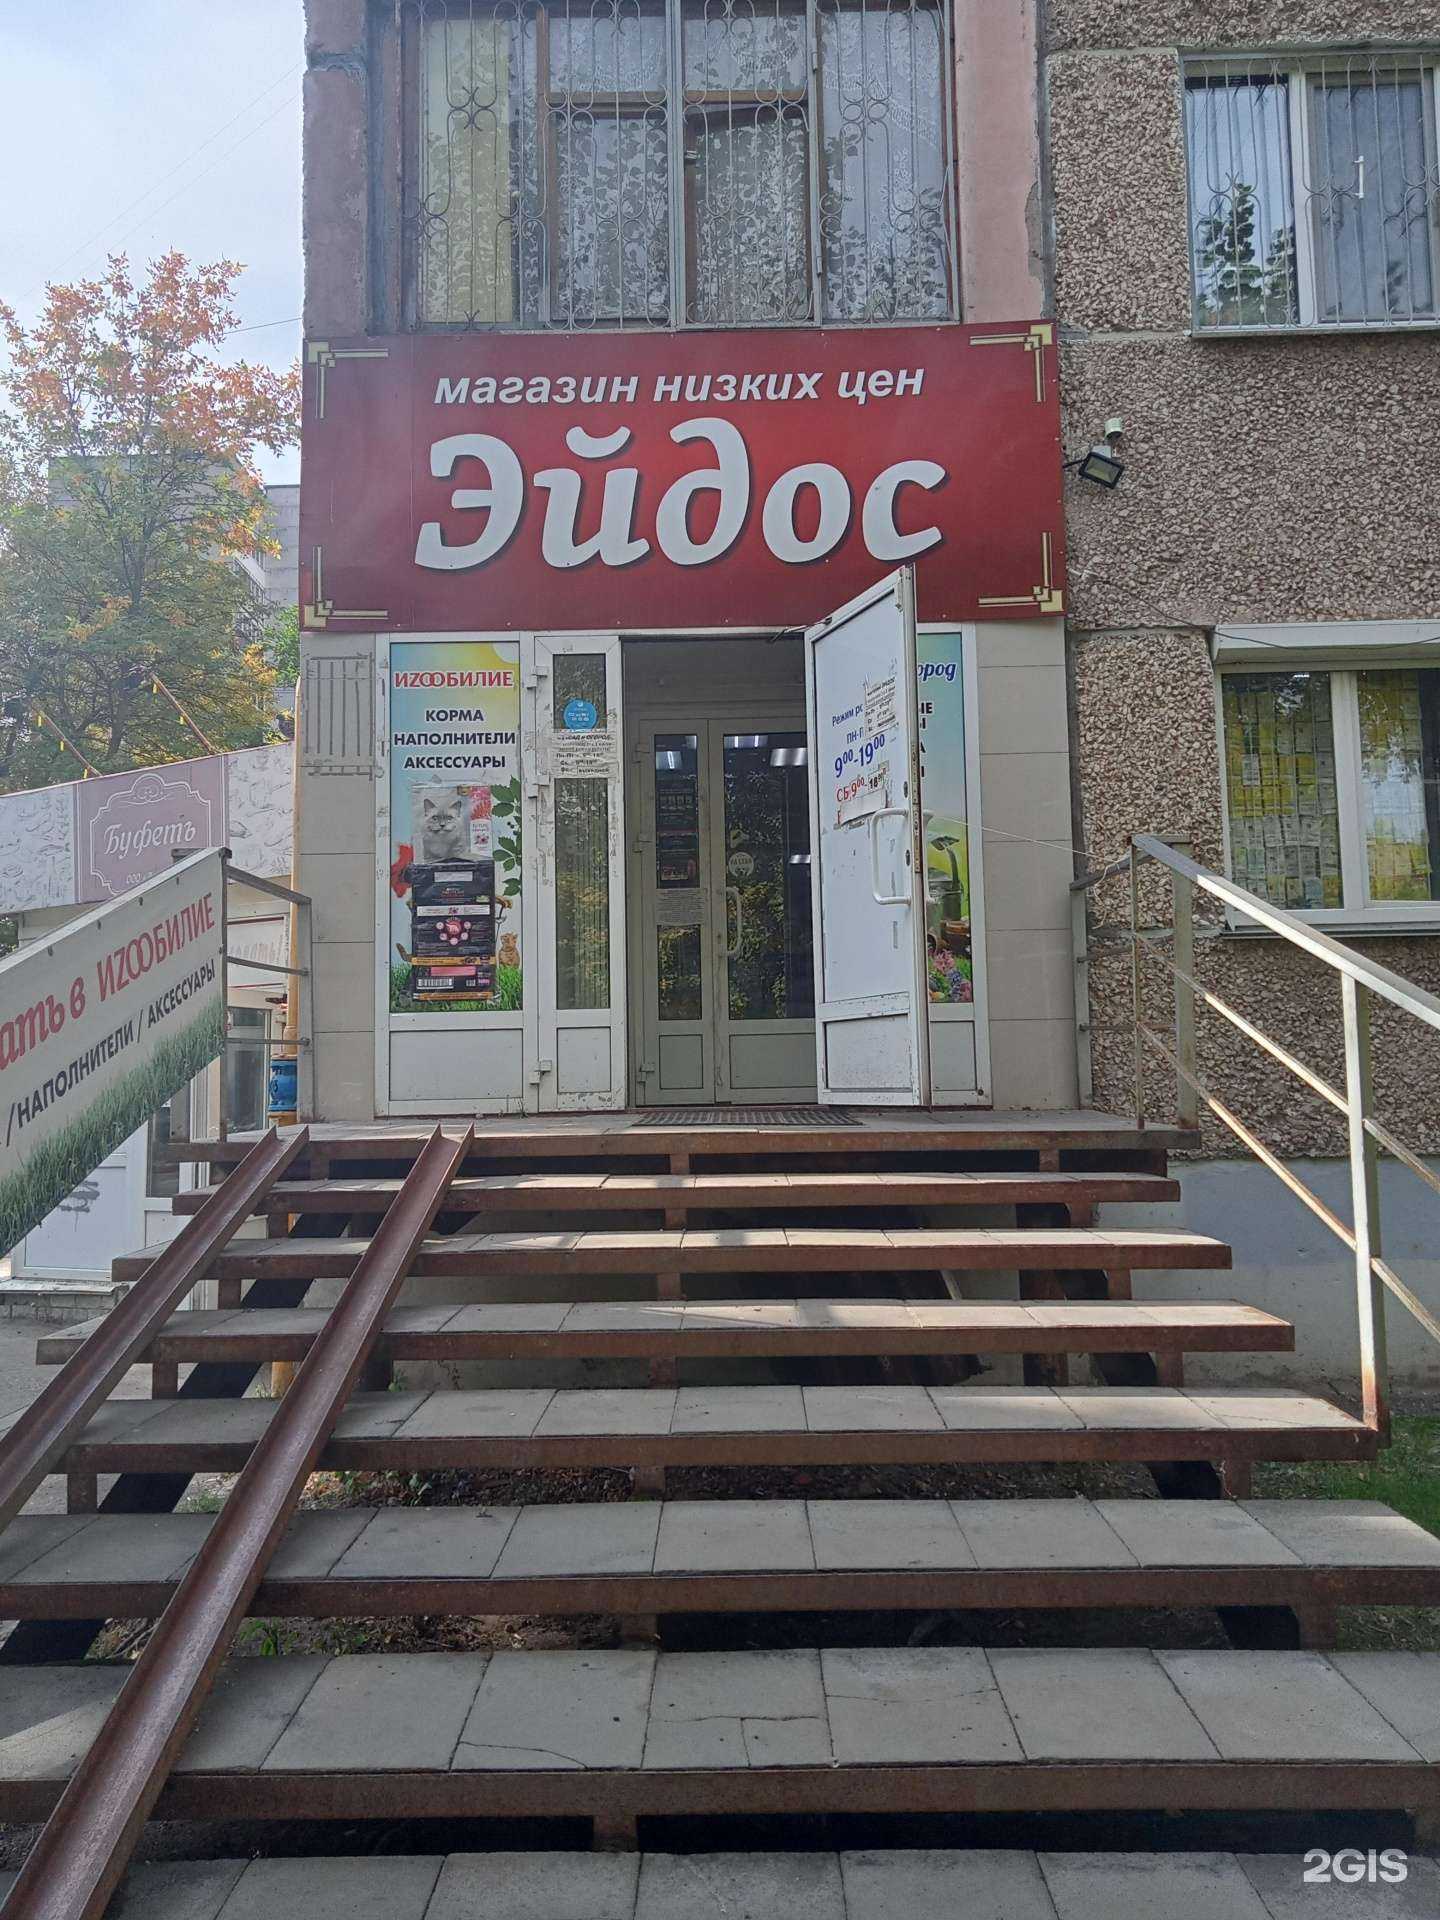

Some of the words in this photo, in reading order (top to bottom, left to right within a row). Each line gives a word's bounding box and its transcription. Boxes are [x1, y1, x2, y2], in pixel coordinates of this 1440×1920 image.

[433, 373, 640, 405] магазин
[652, 369, 823, 402] низких
[837, 366, 925, 401] цен
[414, 417, 947, 570] Эйдос
[425, 709, 484, 722] КОРМА
[394, 732, 516, 747] НАПОЛНИТЕЛИ
[404, 756, 506, 769] АКСЕССУАРЫ
[104, 820, 197, 860] Буфетъ
[0, 995, 66, 1071] ать
[70, 976, 86, 1020] в
[17, 1020, 134, 1129] НАПОЛНИТЕЛИ
[148, 958, 216, 1029] АКСЕССУАРЫ
